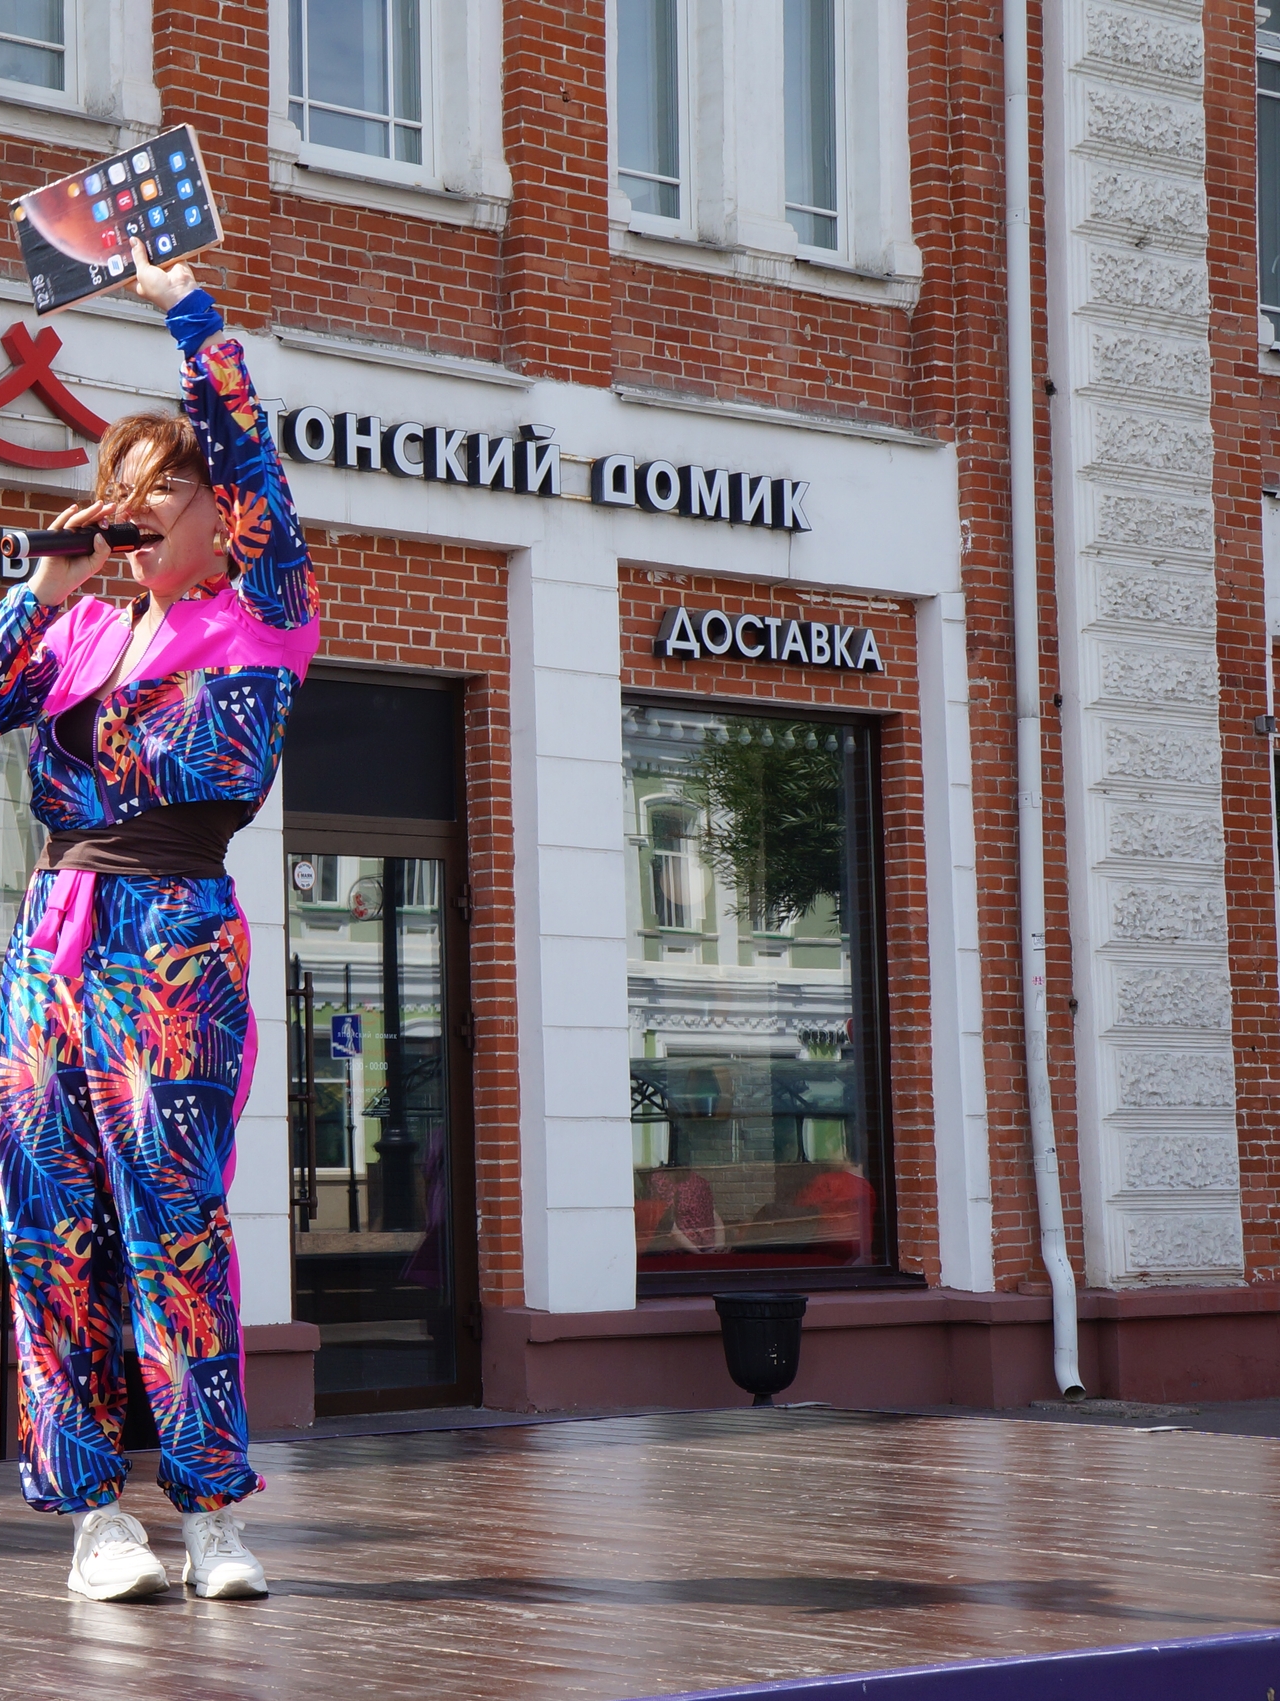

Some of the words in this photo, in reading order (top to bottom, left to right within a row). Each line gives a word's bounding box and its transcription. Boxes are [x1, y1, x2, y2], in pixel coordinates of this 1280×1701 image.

[32, 273, 49, 308] 12:18
[591, 453, 812, 533] ДОМИК
[656, 606, 884, 672] ДОСТАВКА
[370, 1061, 388, 1071] 00:00
